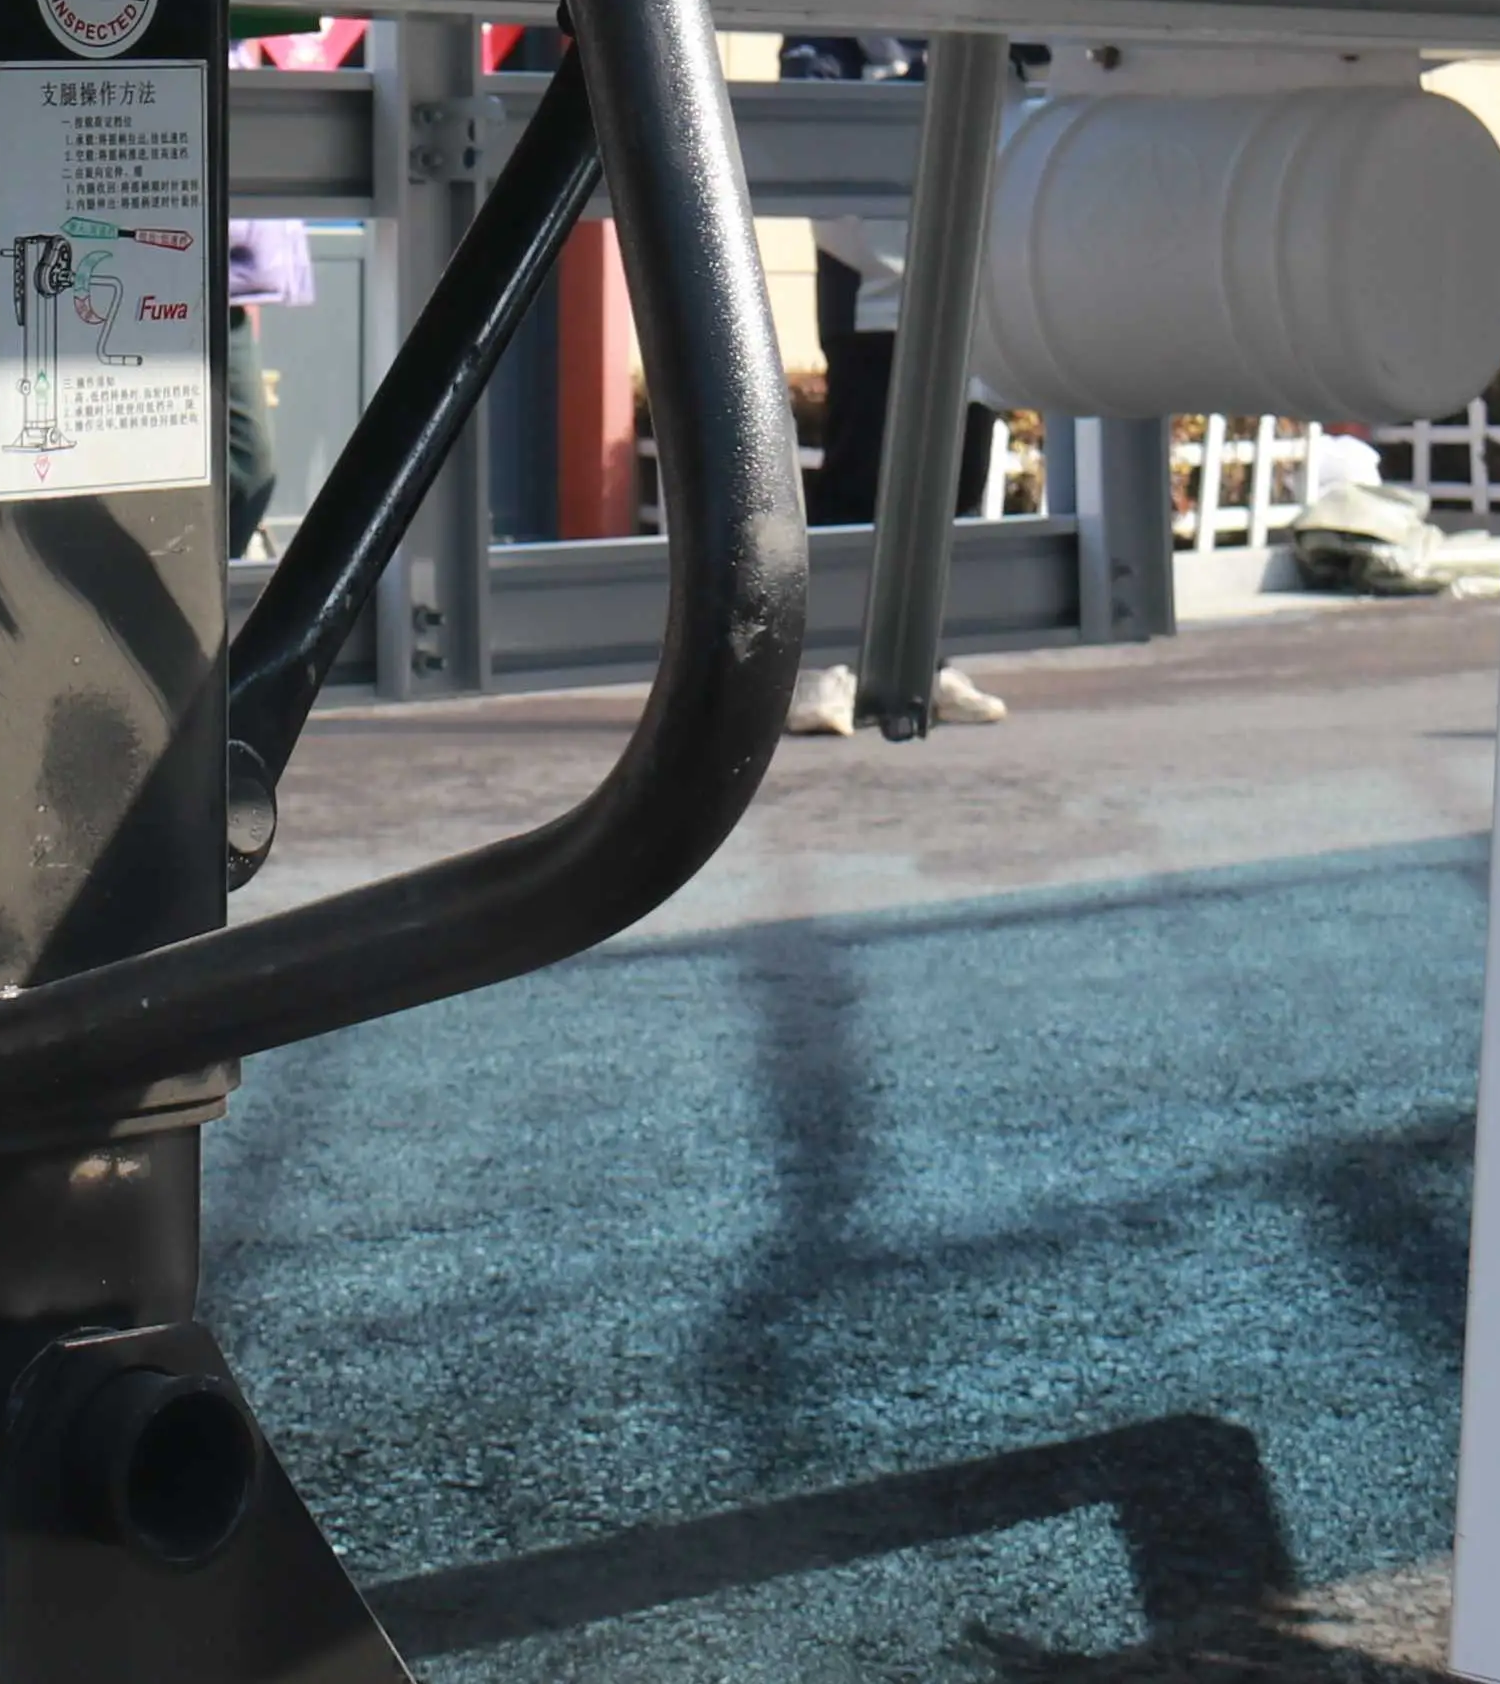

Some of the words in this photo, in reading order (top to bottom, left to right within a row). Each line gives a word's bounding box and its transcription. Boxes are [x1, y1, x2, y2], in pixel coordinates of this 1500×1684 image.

[41, 82, 157, 106] 支腿操作方法
[136, 296, 188, 320] Fuwa
